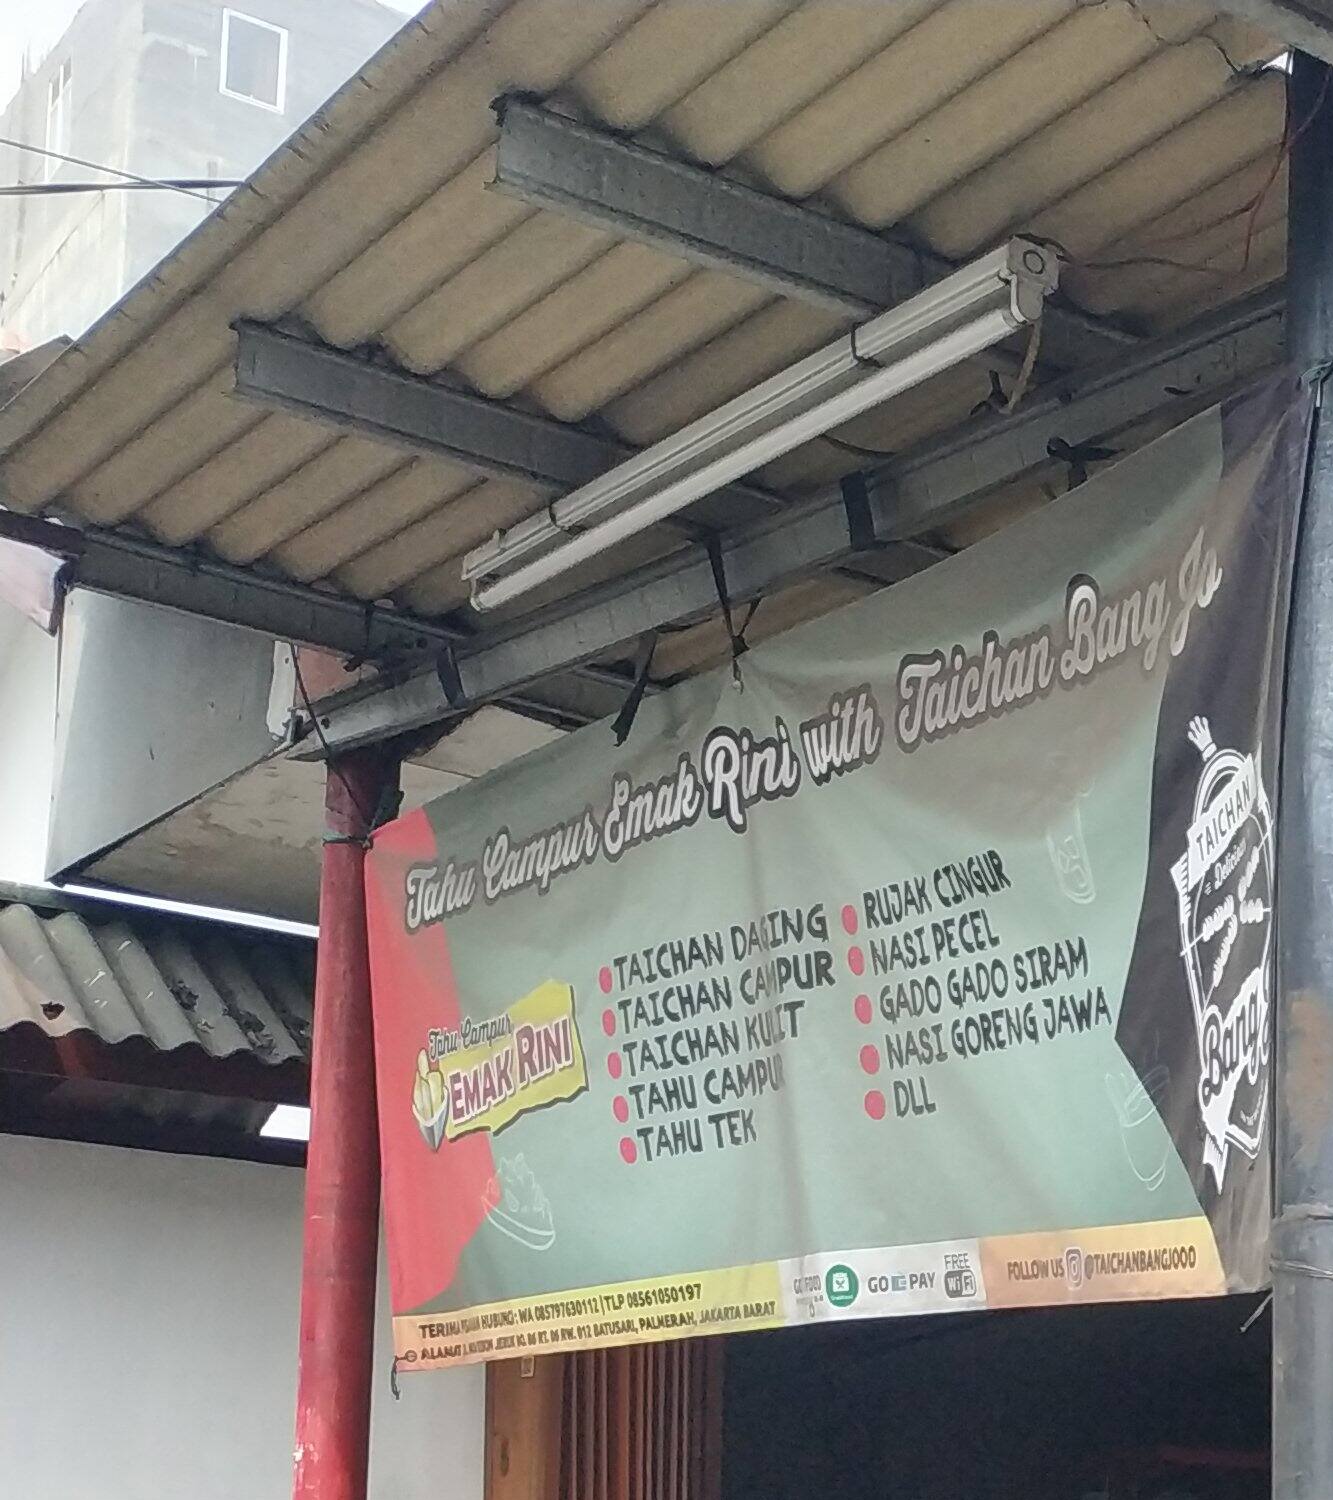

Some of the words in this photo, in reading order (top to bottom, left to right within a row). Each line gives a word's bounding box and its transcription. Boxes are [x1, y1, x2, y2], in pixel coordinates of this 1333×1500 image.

[405, 865, 476, 931] Tahu
[483, 809, 600, 893] Campur
[604, 757, 701, 857] Emak
[704, 721, 799, 829] Rini
[802, 689, 881, 779] with
[899, 637, 1056, 747] Taichan
[1060, 576, 1171, 680] Bang
[1170, 525, 1224, 658] Jo
[1196, 774, 1251, 861] TAICHAN
[863, 876, 932, 929] RUJAK
[933, 850, 1012, 907] CINGUR
[614, 932, 723, 991] TAICHAN
[870, 927, 931, 976] NASI
[932, 909, 1000, 961] PECEL
[618, 976, 732, 1033] TAICHAN
[740, 951, 835, 1004] CAMPUR
[879, 975, 942, 1024] GADO
[947, 959, 1009, 1009] GADO
[1014, 936, 1089, 993] SIRAM
[428, 1029, 458, 1060] Tahu
[460, 1013, 512, 1049] Campur
[623, 1021, 740, 1076] TAICHAN
[885, 1023, 948, 1070] NASI
[952, 1002, 1039, 1059] GORENG
[1042, 986, 1113, 1040] JAWA
[449, 1047, 514, 1121] EMAK
[515, 1017, 572, 1084] RINI
[628, 1075, 698, 1119] TAHU
[894, 1076, 937, 1118] DLL
[637, 1118, 703, 1161] TAHU
[708, 1109, 757, 1148] TEK
[909, 1271, 937, 1290] PAY
[943, 1252, 971, 1270] FREE
[1007, 1259, 1050, 1281] FOLLOW
[1050, 1257, 1065, 1278] US
[518, 1306, 535, 1325] WA
